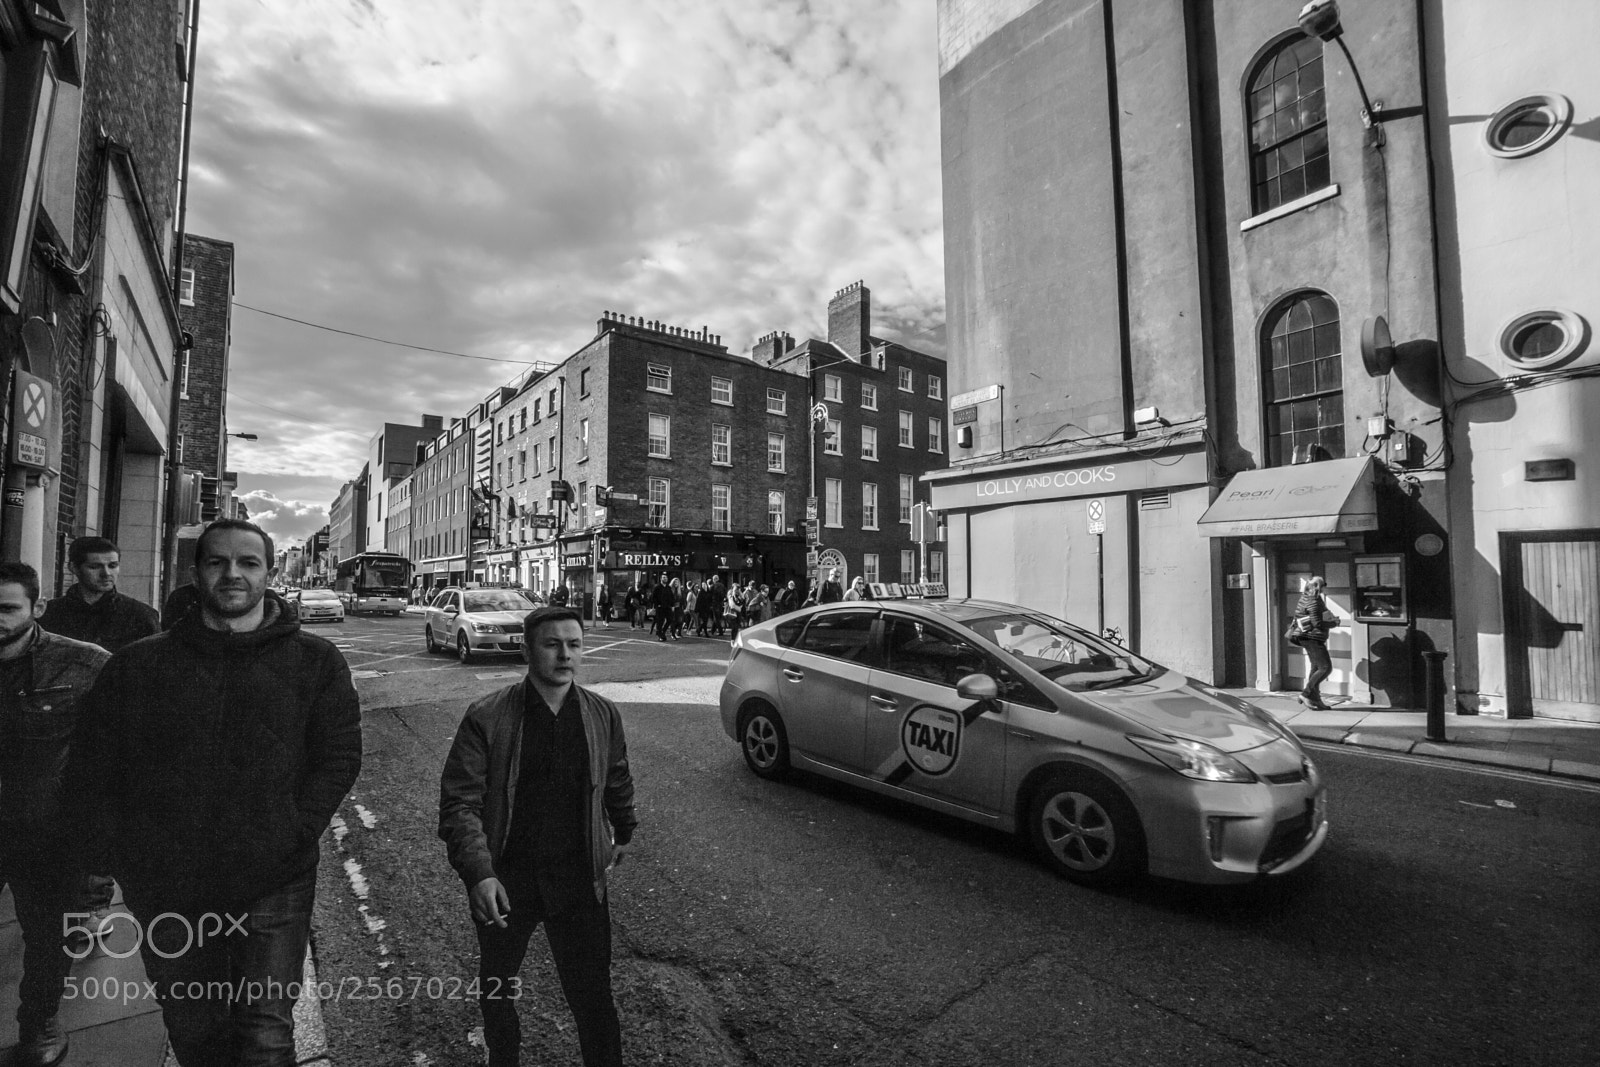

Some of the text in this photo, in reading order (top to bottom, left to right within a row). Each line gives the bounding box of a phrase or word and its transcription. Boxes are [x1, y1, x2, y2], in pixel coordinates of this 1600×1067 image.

[976, 465, 1116, 497] LOLLY AND COOKS
[1229, 487, 1275, 499] Pearl
[1256, 521, 1299, 532] BRASSERIE
[624, 554, 681, 567] REILLY'S
[900, 584, 922, 596] TAXI
[908, 720, 955, 758] TAXI
